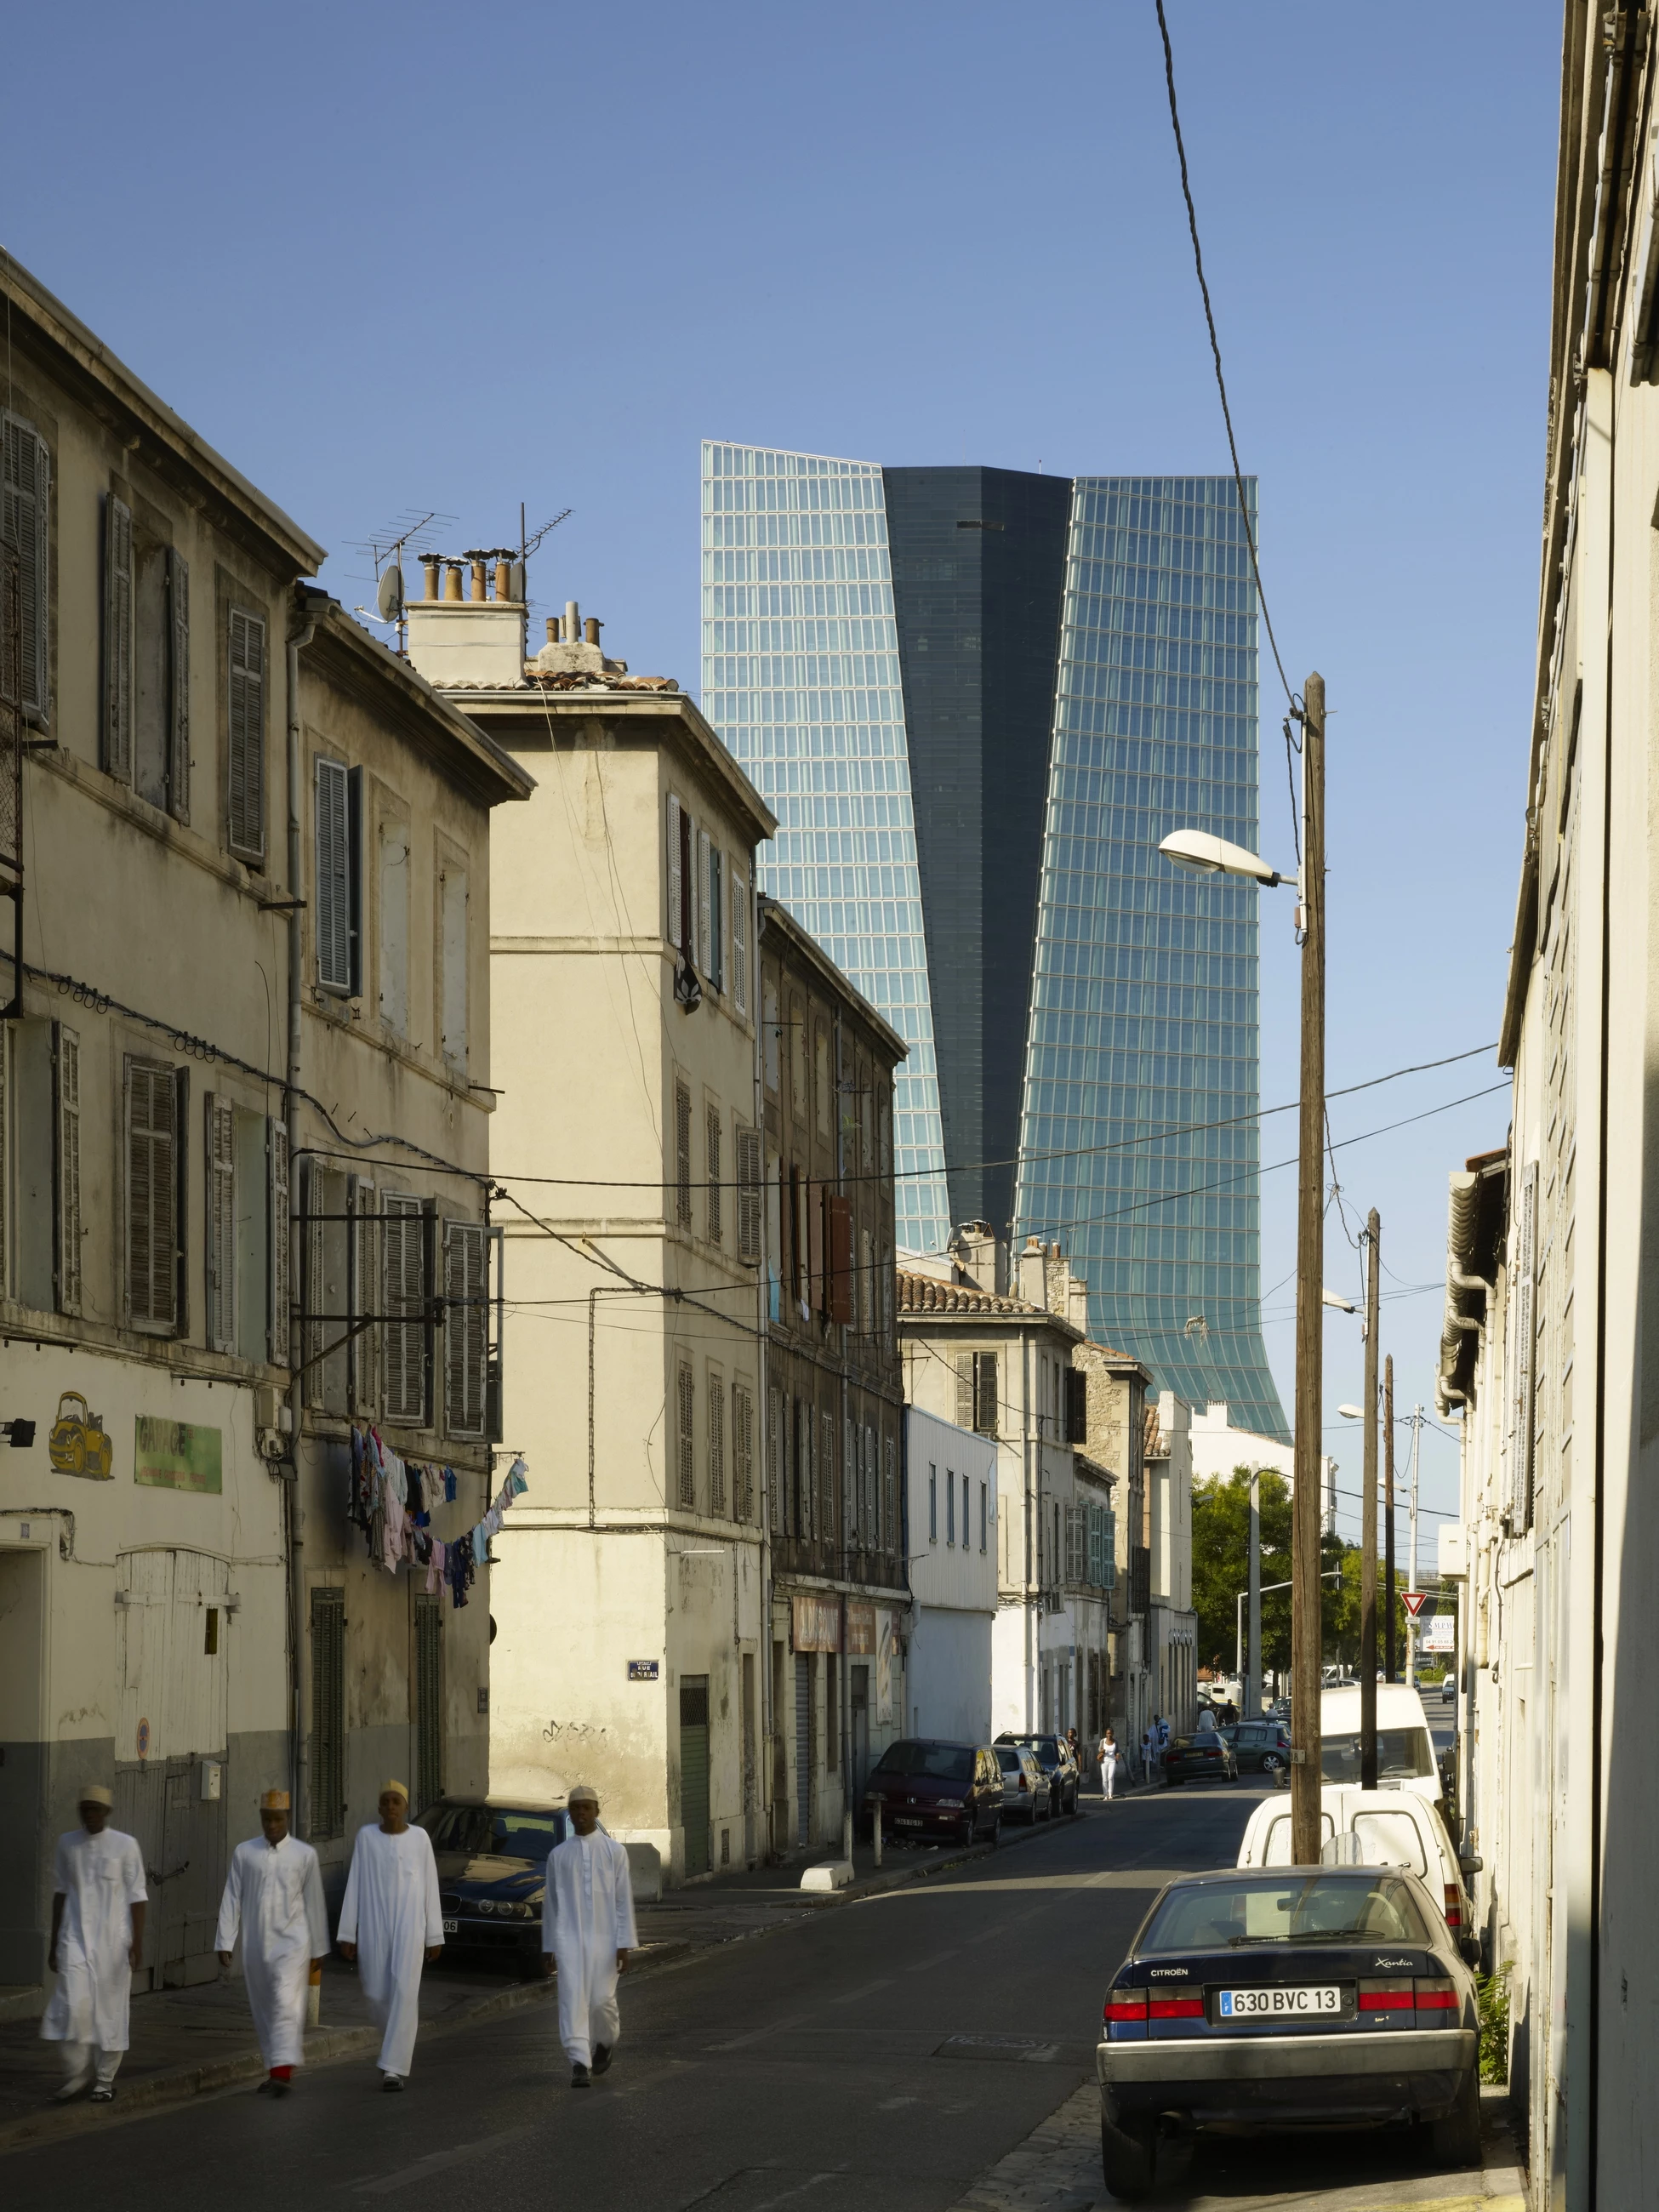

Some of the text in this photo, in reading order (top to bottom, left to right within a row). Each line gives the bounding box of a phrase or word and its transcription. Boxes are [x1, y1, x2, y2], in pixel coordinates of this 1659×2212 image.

[140, 1417, 186, 1456] GARAGE
[444, 1921, 456, 1930] 06
[1375, 1957, 1413, 1969] Xantia
[1150, 1968, 1189, 1977] CITROËN
[1234, 1993, 1269, 2012] 630
[1274, 1991, 1308, 2010] BVC
[1314, 1990, 1336, 2009] 13
